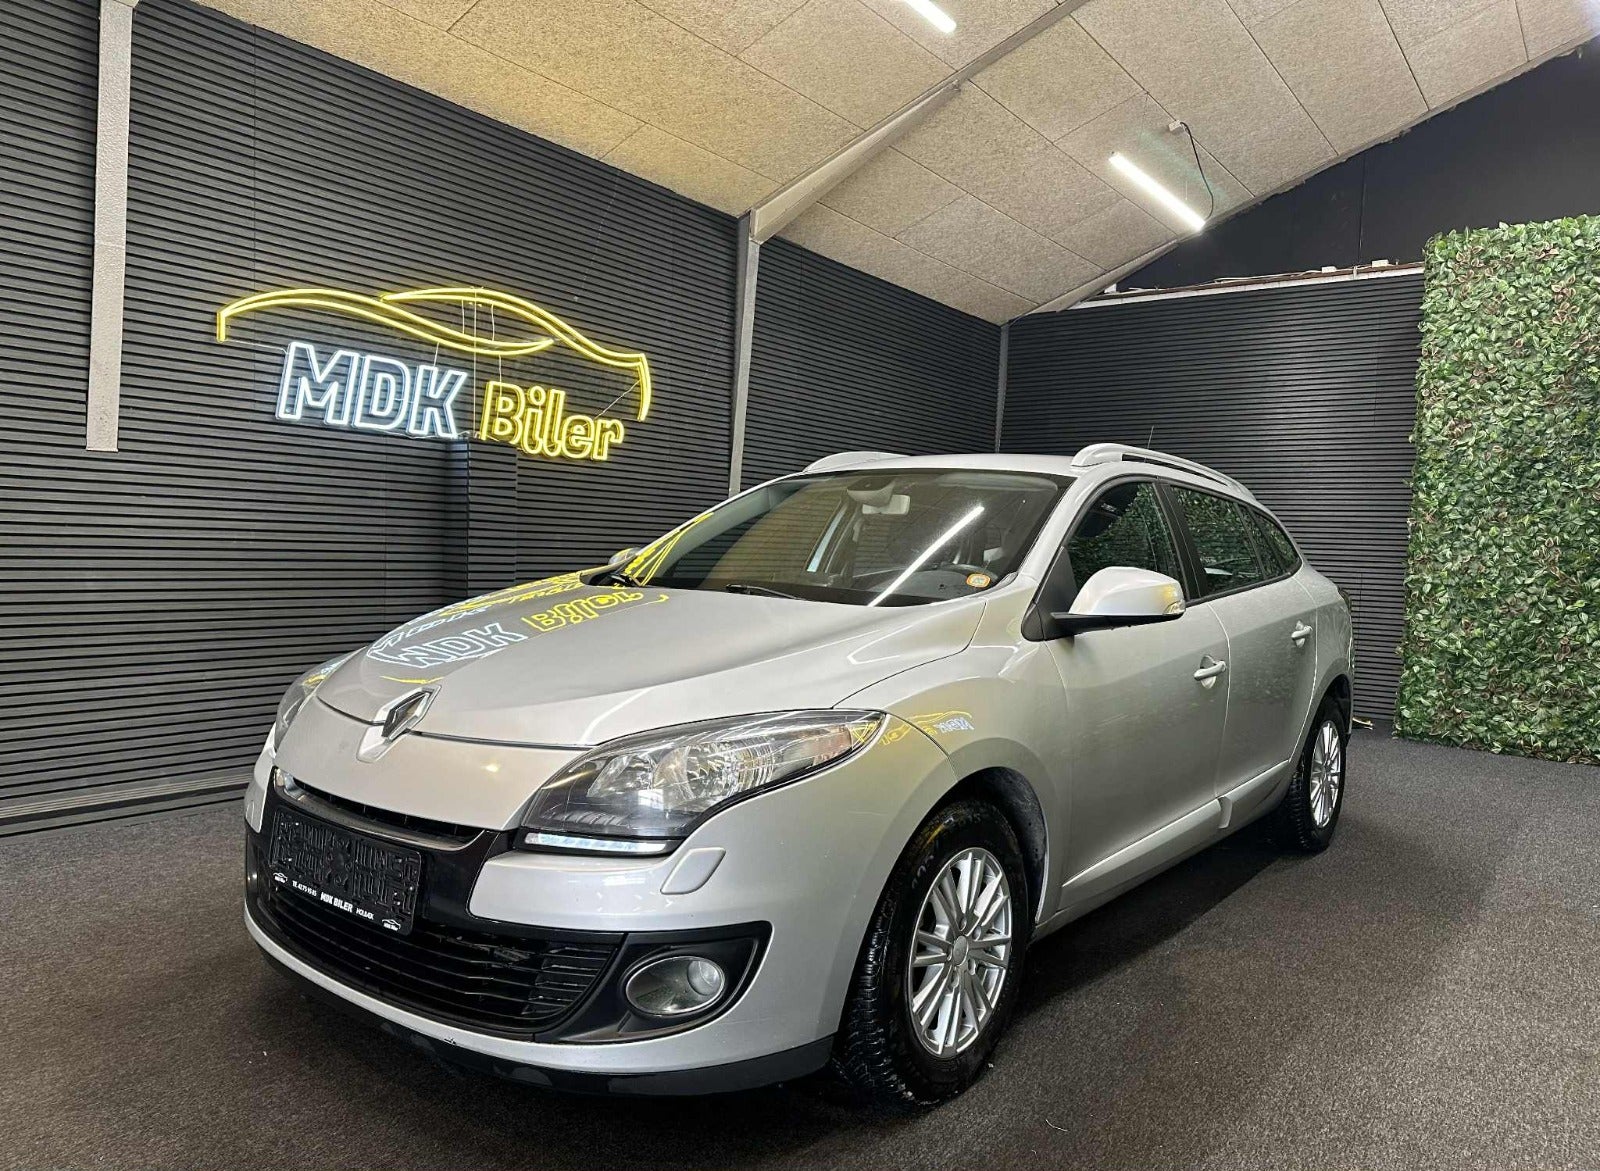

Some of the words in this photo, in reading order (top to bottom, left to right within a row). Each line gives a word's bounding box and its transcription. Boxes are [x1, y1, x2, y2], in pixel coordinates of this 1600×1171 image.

[276, 341, 468, 439] MDK
[480, 380, 625, 461] Biler
[333, 897, 354, 913] BILER
